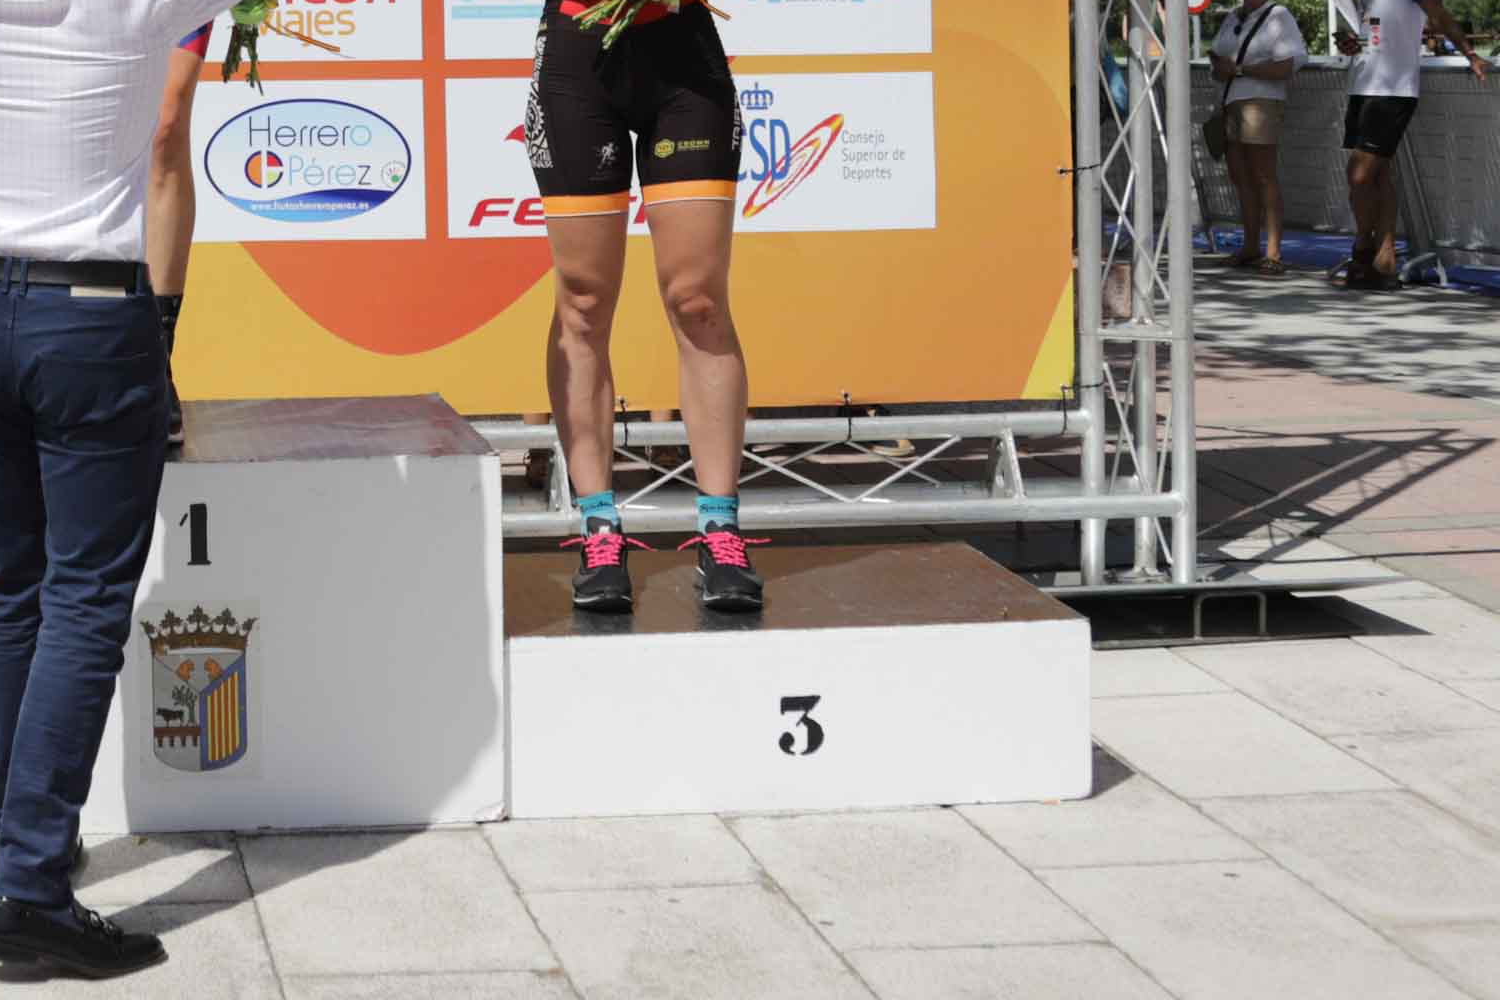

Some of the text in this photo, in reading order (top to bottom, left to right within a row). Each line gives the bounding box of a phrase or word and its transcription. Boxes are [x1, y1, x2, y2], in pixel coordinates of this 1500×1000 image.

[248, 115, 372, 147] Herrero
[841, 129, 886, 148] Consejo
[288, 154, 372, 187] Pérez
[840, 147, 907, 164] Superior de
[841, 164, 893, 183] Deportes
[179, 503, 212, 566] 1
[778, 694, 825, 757] 3
